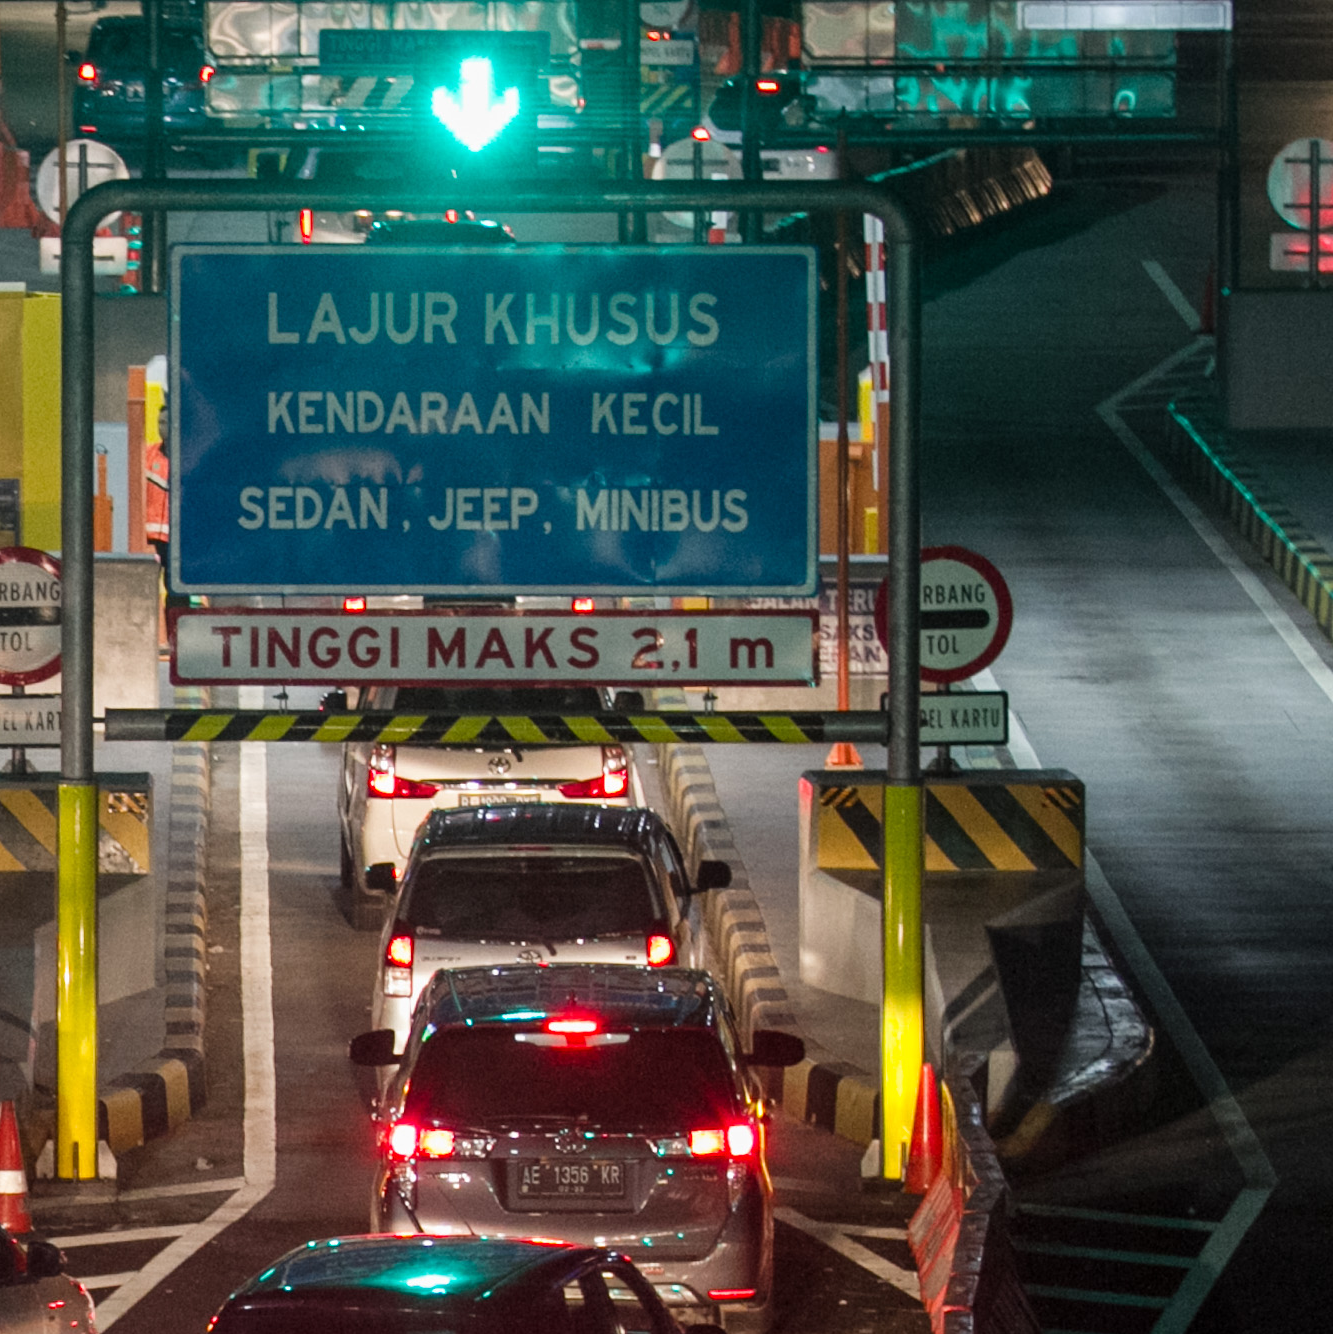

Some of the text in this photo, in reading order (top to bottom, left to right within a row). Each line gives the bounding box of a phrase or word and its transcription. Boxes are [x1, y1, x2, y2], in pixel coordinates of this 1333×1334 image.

[268, 291, 720, 347] LAJUR KHUSUS
[268, 391, 720, 435] KENDARAAN KECIL
[427, 487, 552, 535] JEEP,
[576, 488, 749, 533] MINIBUS
[923, 584, 986, 604] RBANG
[0, 631, 33, 651] TOL
[211, 625, 776, 672] TINGGI MAKS 2,1 m
[926, 634, 959, 655] TOL
[25, 711, 62, 731] KART
[951, 710, 1001, 729] KARTU
[522, 1166, 620, 1184] AE 1356 KR
